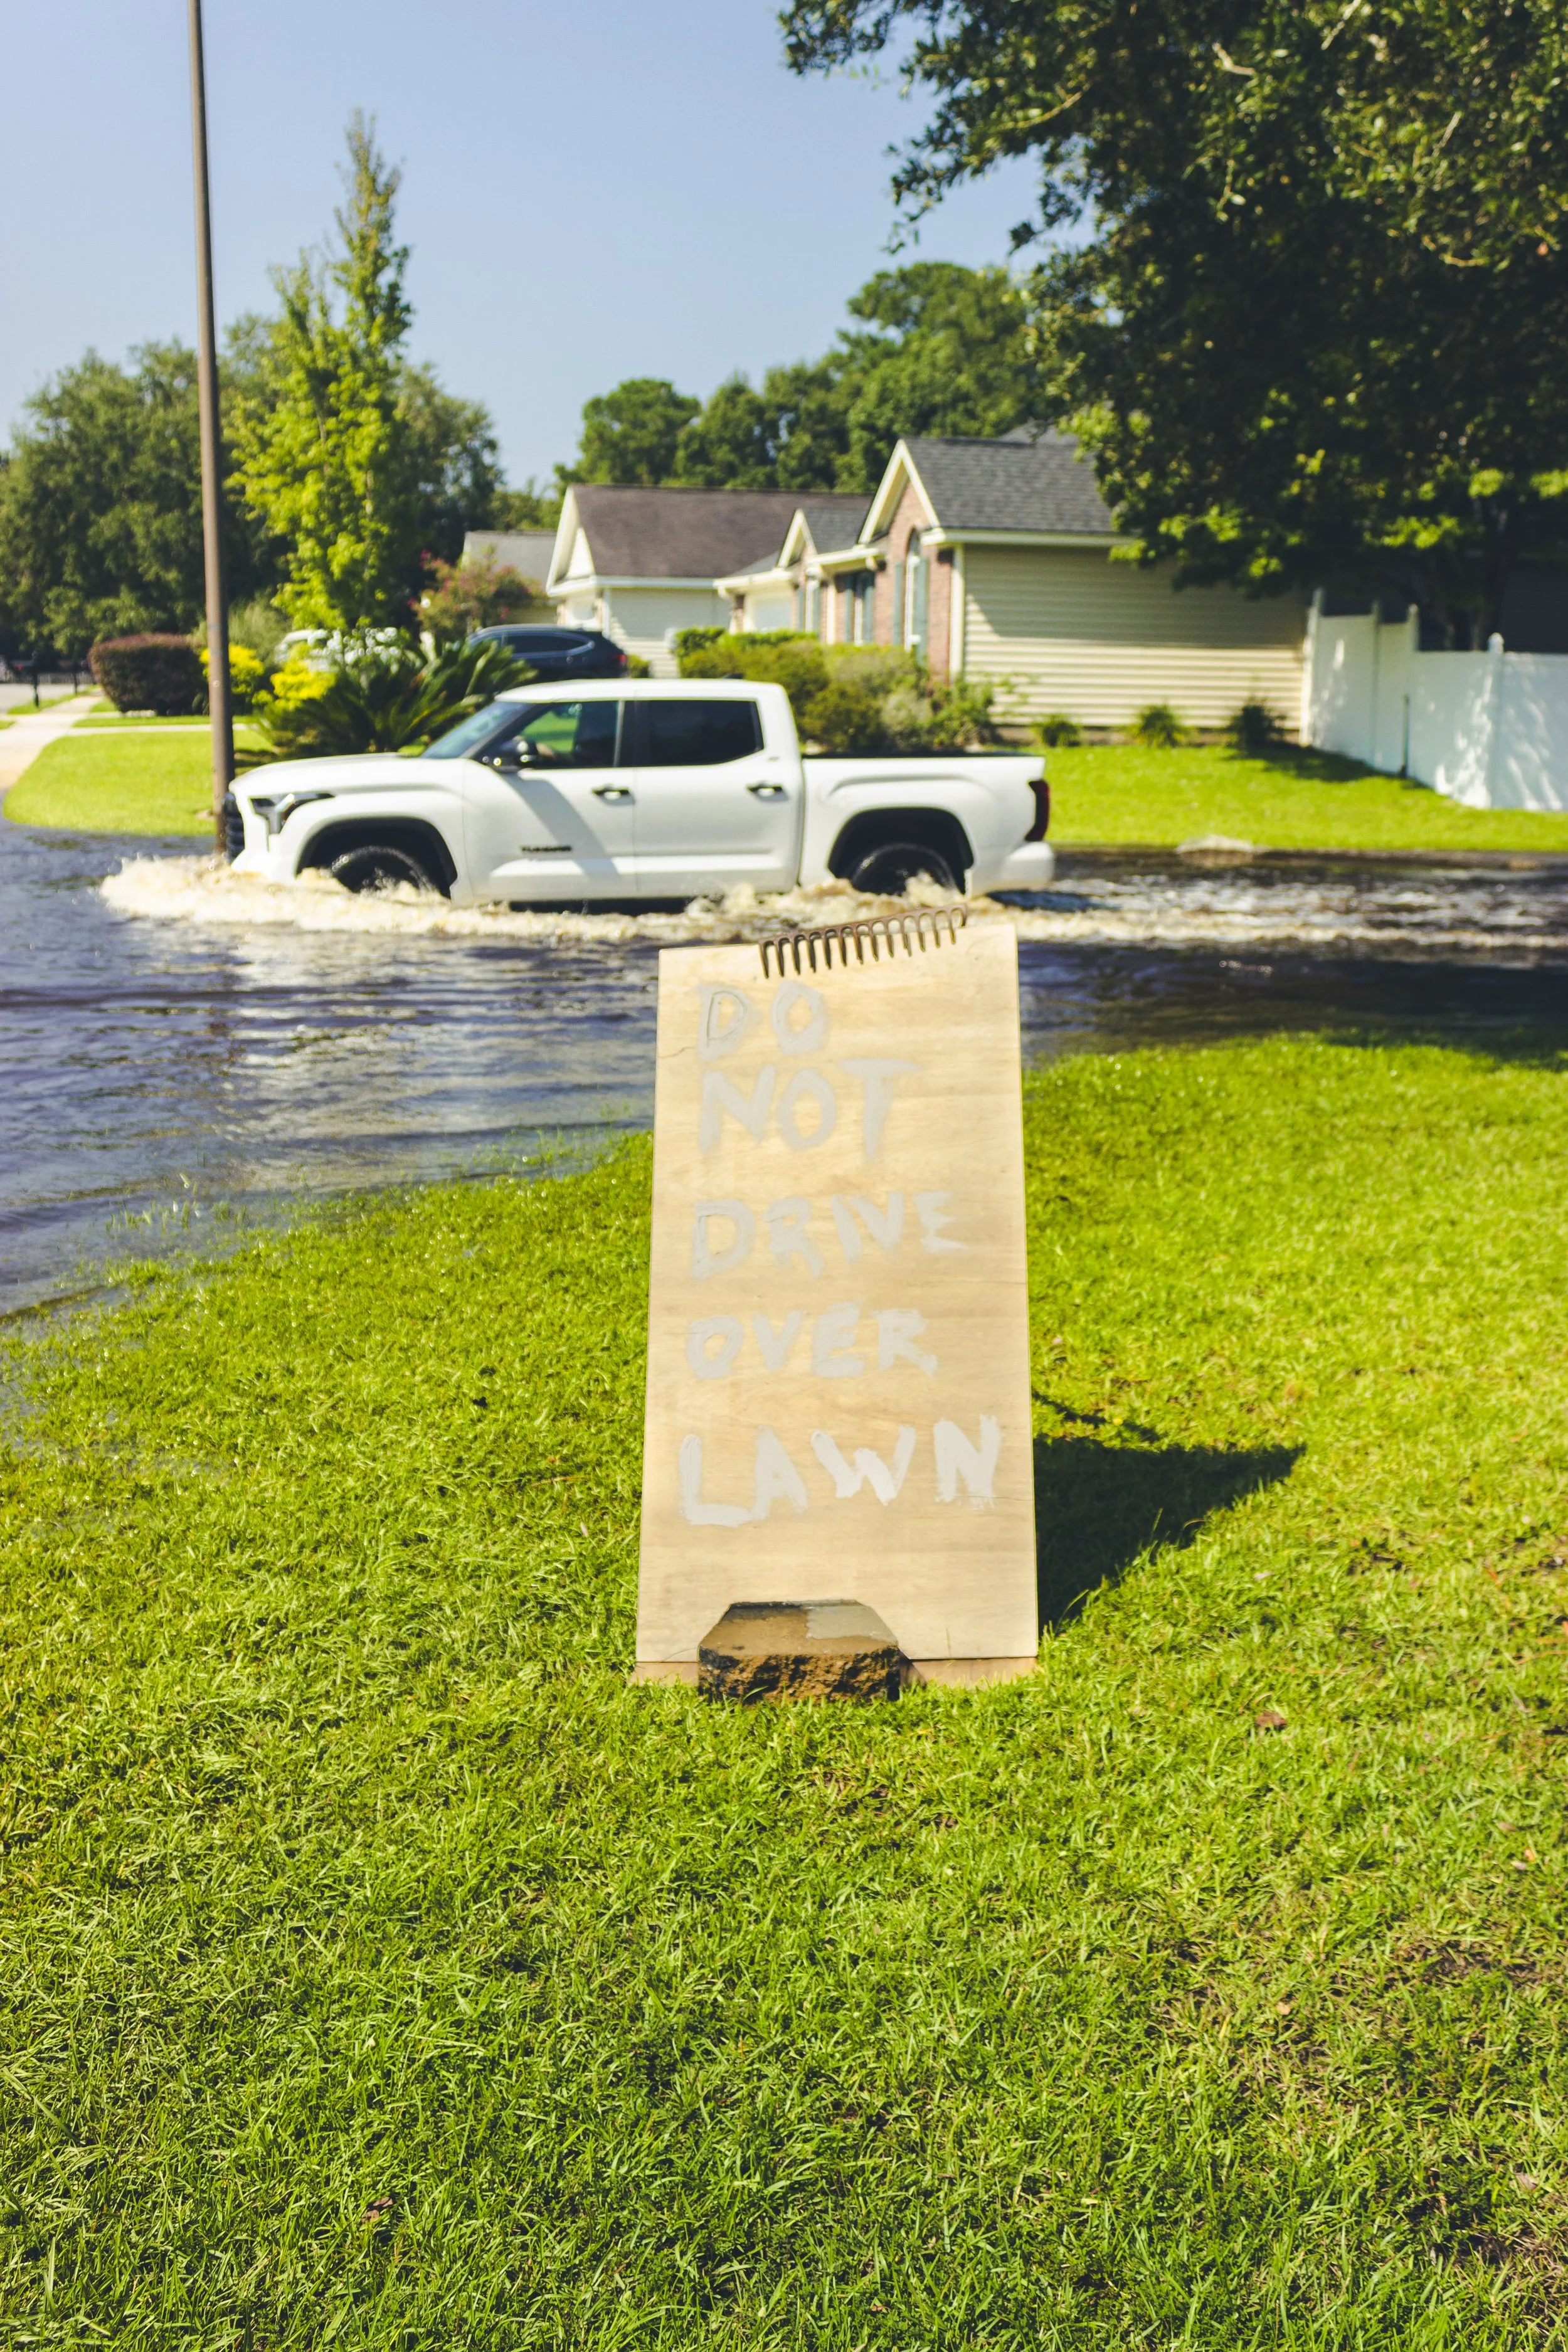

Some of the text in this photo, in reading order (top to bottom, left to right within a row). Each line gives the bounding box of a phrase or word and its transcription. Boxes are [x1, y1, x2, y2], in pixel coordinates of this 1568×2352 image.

[697, 980, 827, 1061] DO
[698, 1057, 922, 1157] NOT
[690, 1190, 967, 1279] DRIVE
[686, 1303, 939, 1379] OVER
[679, 1414, 1002, 1527] LAWN
